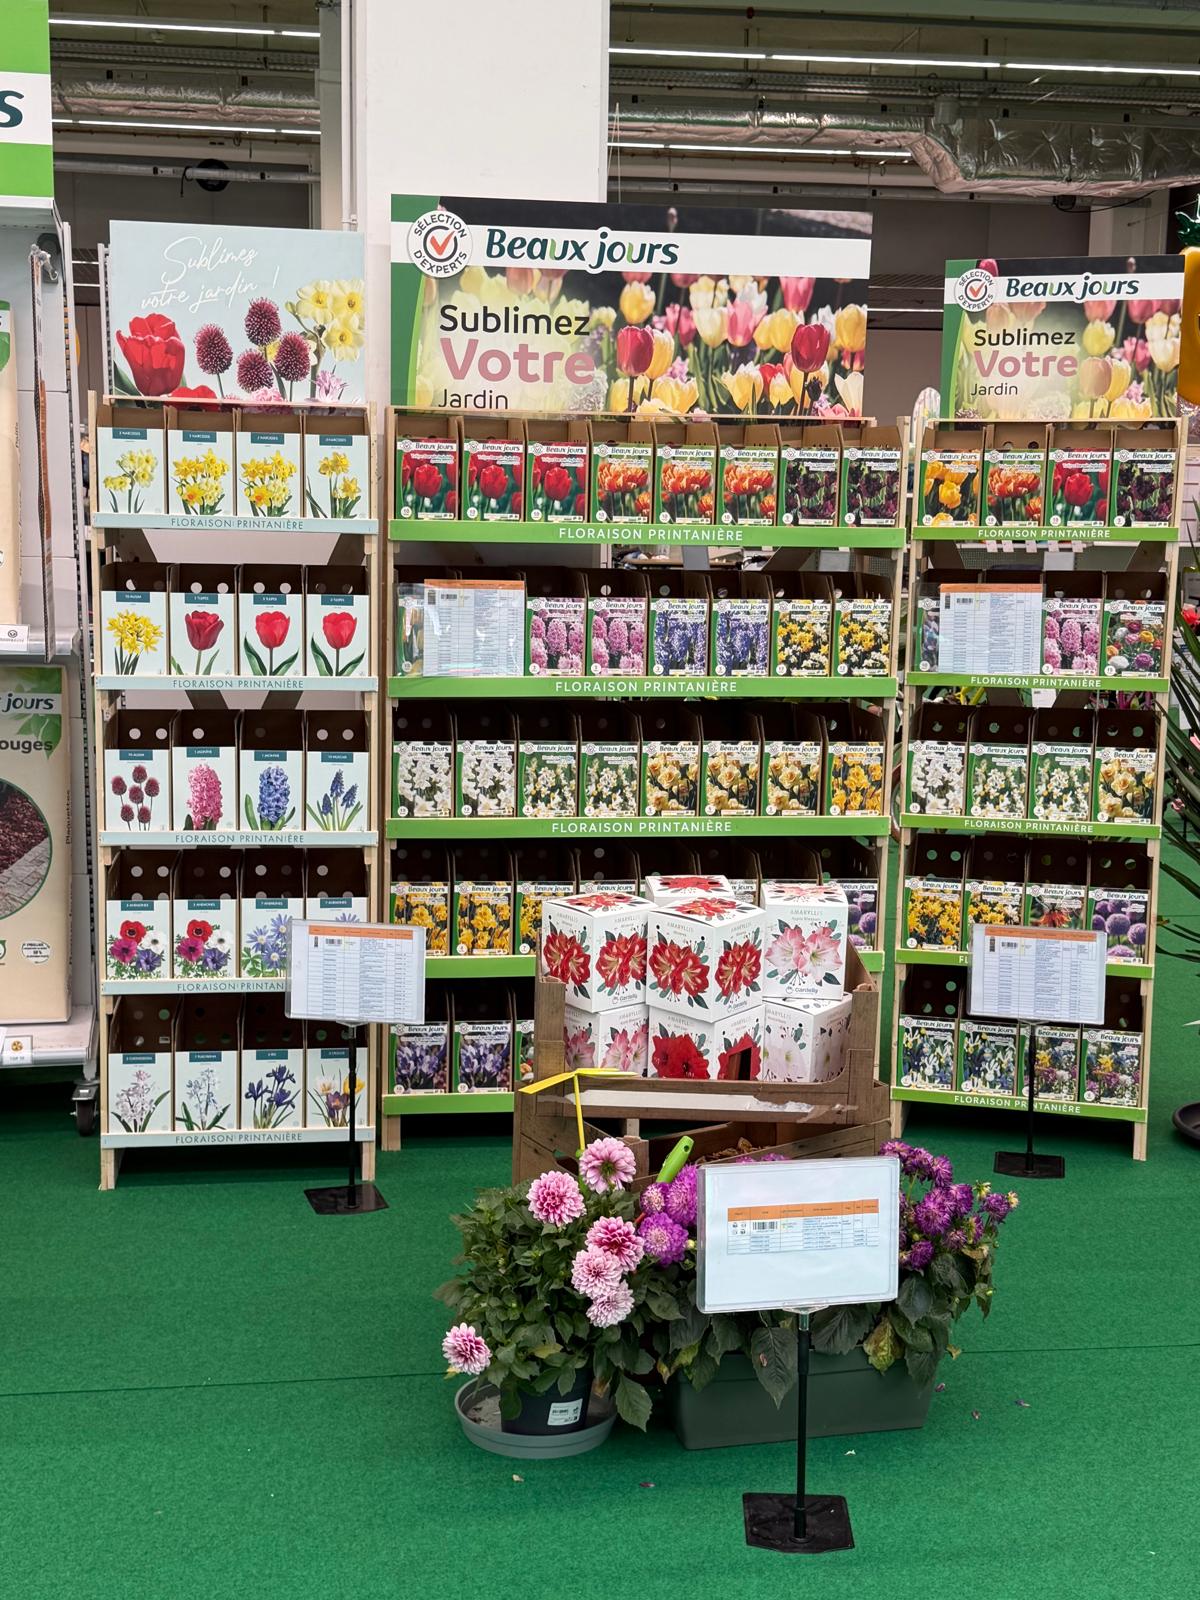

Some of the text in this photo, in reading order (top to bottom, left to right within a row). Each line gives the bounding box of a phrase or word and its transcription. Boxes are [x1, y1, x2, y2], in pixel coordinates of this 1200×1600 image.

[413, 213, 468, 239] SÉLECTION
[486, 226, 680, 269] Beaux jours
[413, 250, 469, 275] D'EXPERTS
[958, 270, 995, 287] SÉLECTION
[141, 282, 190, 309] votre
[189, 271, 258, 313] jardin
[1006, 275, 1140, 301] Beaux jours
[957, 293, 994, 311] D'EXPERTS
[439, 304, 591, 336] Sublimez
[974, 329, 1076, 347] Sublimez
[440, 337, 595, 385] Votre
[974, 350, 1078, 378] Votre
[971, 383, 1018, 396] Jardin
[438, 388, 509, 410] Jardin
[171, 518, 304, 530] FLORAISON PRINTANIÈRE
[559, 527, 743, 541] FLORAISON PRINTANIÈRE
[978, 528, 1110, 538] FLORAISON PRINTANIÈRE
[173, 679, 304, 688] FLORAISON PRINTANIÈRE
[556, 679, 737, 692] FLORAISON PRINTANIÈRE
[971, 676, 1101, 688] FLORAISON PRINTANIÈRE
[2, 693, 55, 713] jours
[0, 739, 53, 754] ouges
[552, 821, 732, 833] FLORAISON PRINTANIÈRE
[964, 820, 1094, 833] FLORAISON PRINTANIÈRE
[175, 833, 304, 843] FLORAISON PRINTANIÈRE
[177, 982, 285, 991] FLORAISON PRINTAN
[954, 1095, 1081, 1114] FLORAISON PRNTANIÈRE
[175, 1132, 303, 1144] FLORAISON PRINTANIÈRE
